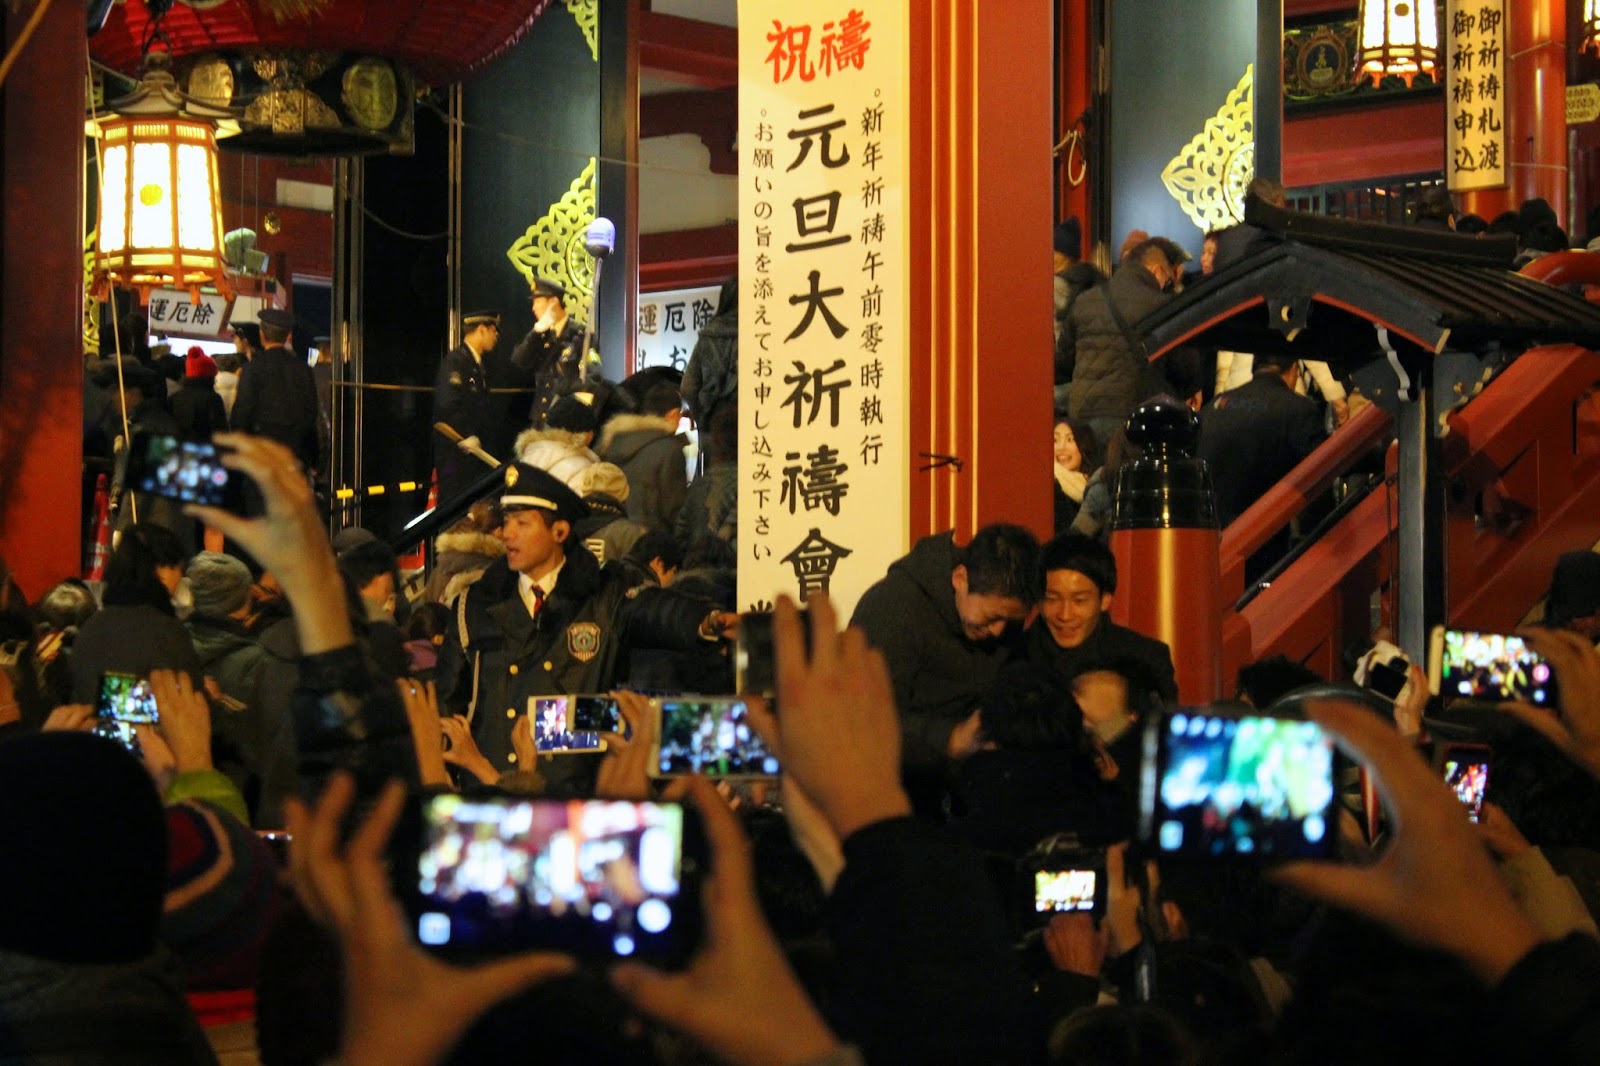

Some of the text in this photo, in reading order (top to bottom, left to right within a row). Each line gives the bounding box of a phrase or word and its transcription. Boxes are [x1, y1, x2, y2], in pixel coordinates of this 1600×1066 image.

[764, 9, 871, 84] 祝禱
[1452, 10, 1477, 173] 御祈祷申込
[1478, 6, 1501, 170] 御祈祷札渡
